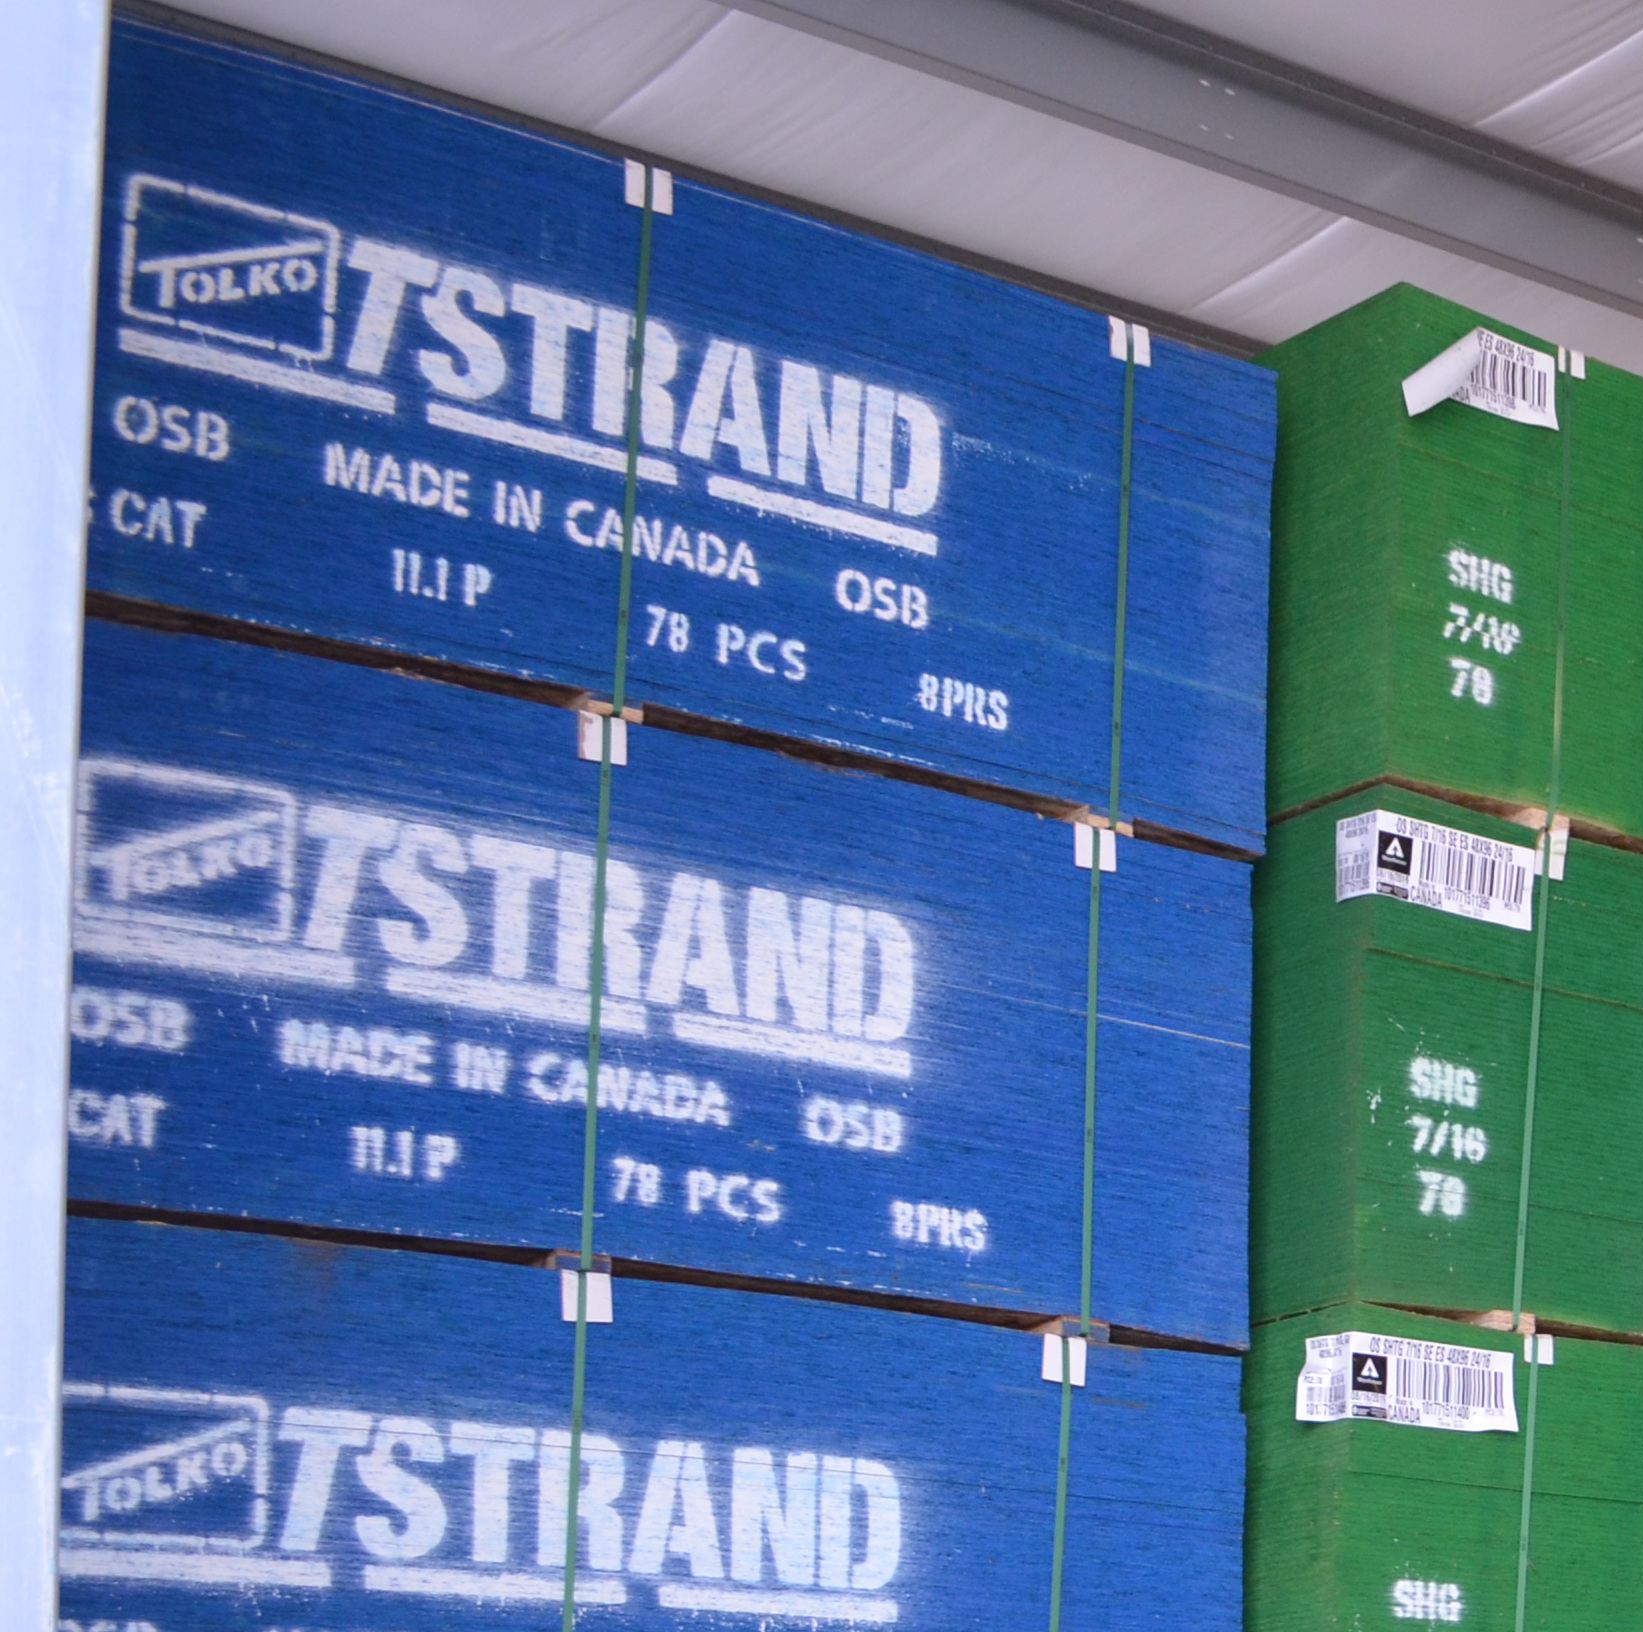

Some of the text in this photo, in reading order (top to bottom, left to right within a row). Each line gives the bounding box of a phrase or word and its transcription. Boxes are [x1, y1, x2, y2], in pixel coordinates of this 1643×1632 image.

[138, 245, 322, 310] TOLKO
[342, 237, 943, 517] TSTRAND
[113, 396, 230, 461] OSB
[110, 489, 206, 548] CAT
[324, 443, 760, 587] MADE IN CANADA
[836, 569, 929, 629] OSB
[1447, 549, 1512, 603] SHG
[647, 605, 806, 680] 78 PCS
[1443, 603, 1520, 654] 7/16
[917, 673, 1008, 730] 8PRS
[301, 800, 918, 1043] TSTRAND
[1410, 886, 1443, 909] CANADA
[71, 986, 190, 1050] OSB
[278, 1019, 731, 1126] MADE IN CANADA
[1409, 1056, 1478, 1107] SHG
[68, 1090, 166, 1149] CAT
[804, 1095, 906, 1152] OSB
[1411, 1115, 1486, 1161] 7/16
[612, 1156, 782, 1224] 78 PCS
[1417, 1170, 1465, 1216] 78
[1388, 1404, 1421, 1424] CANADA
[66, 1438, 248, 1523] TOLKO
[277, 1406, 902, 1591] TSTRAND
[1392, 1580, 1463, 1621] SHG
